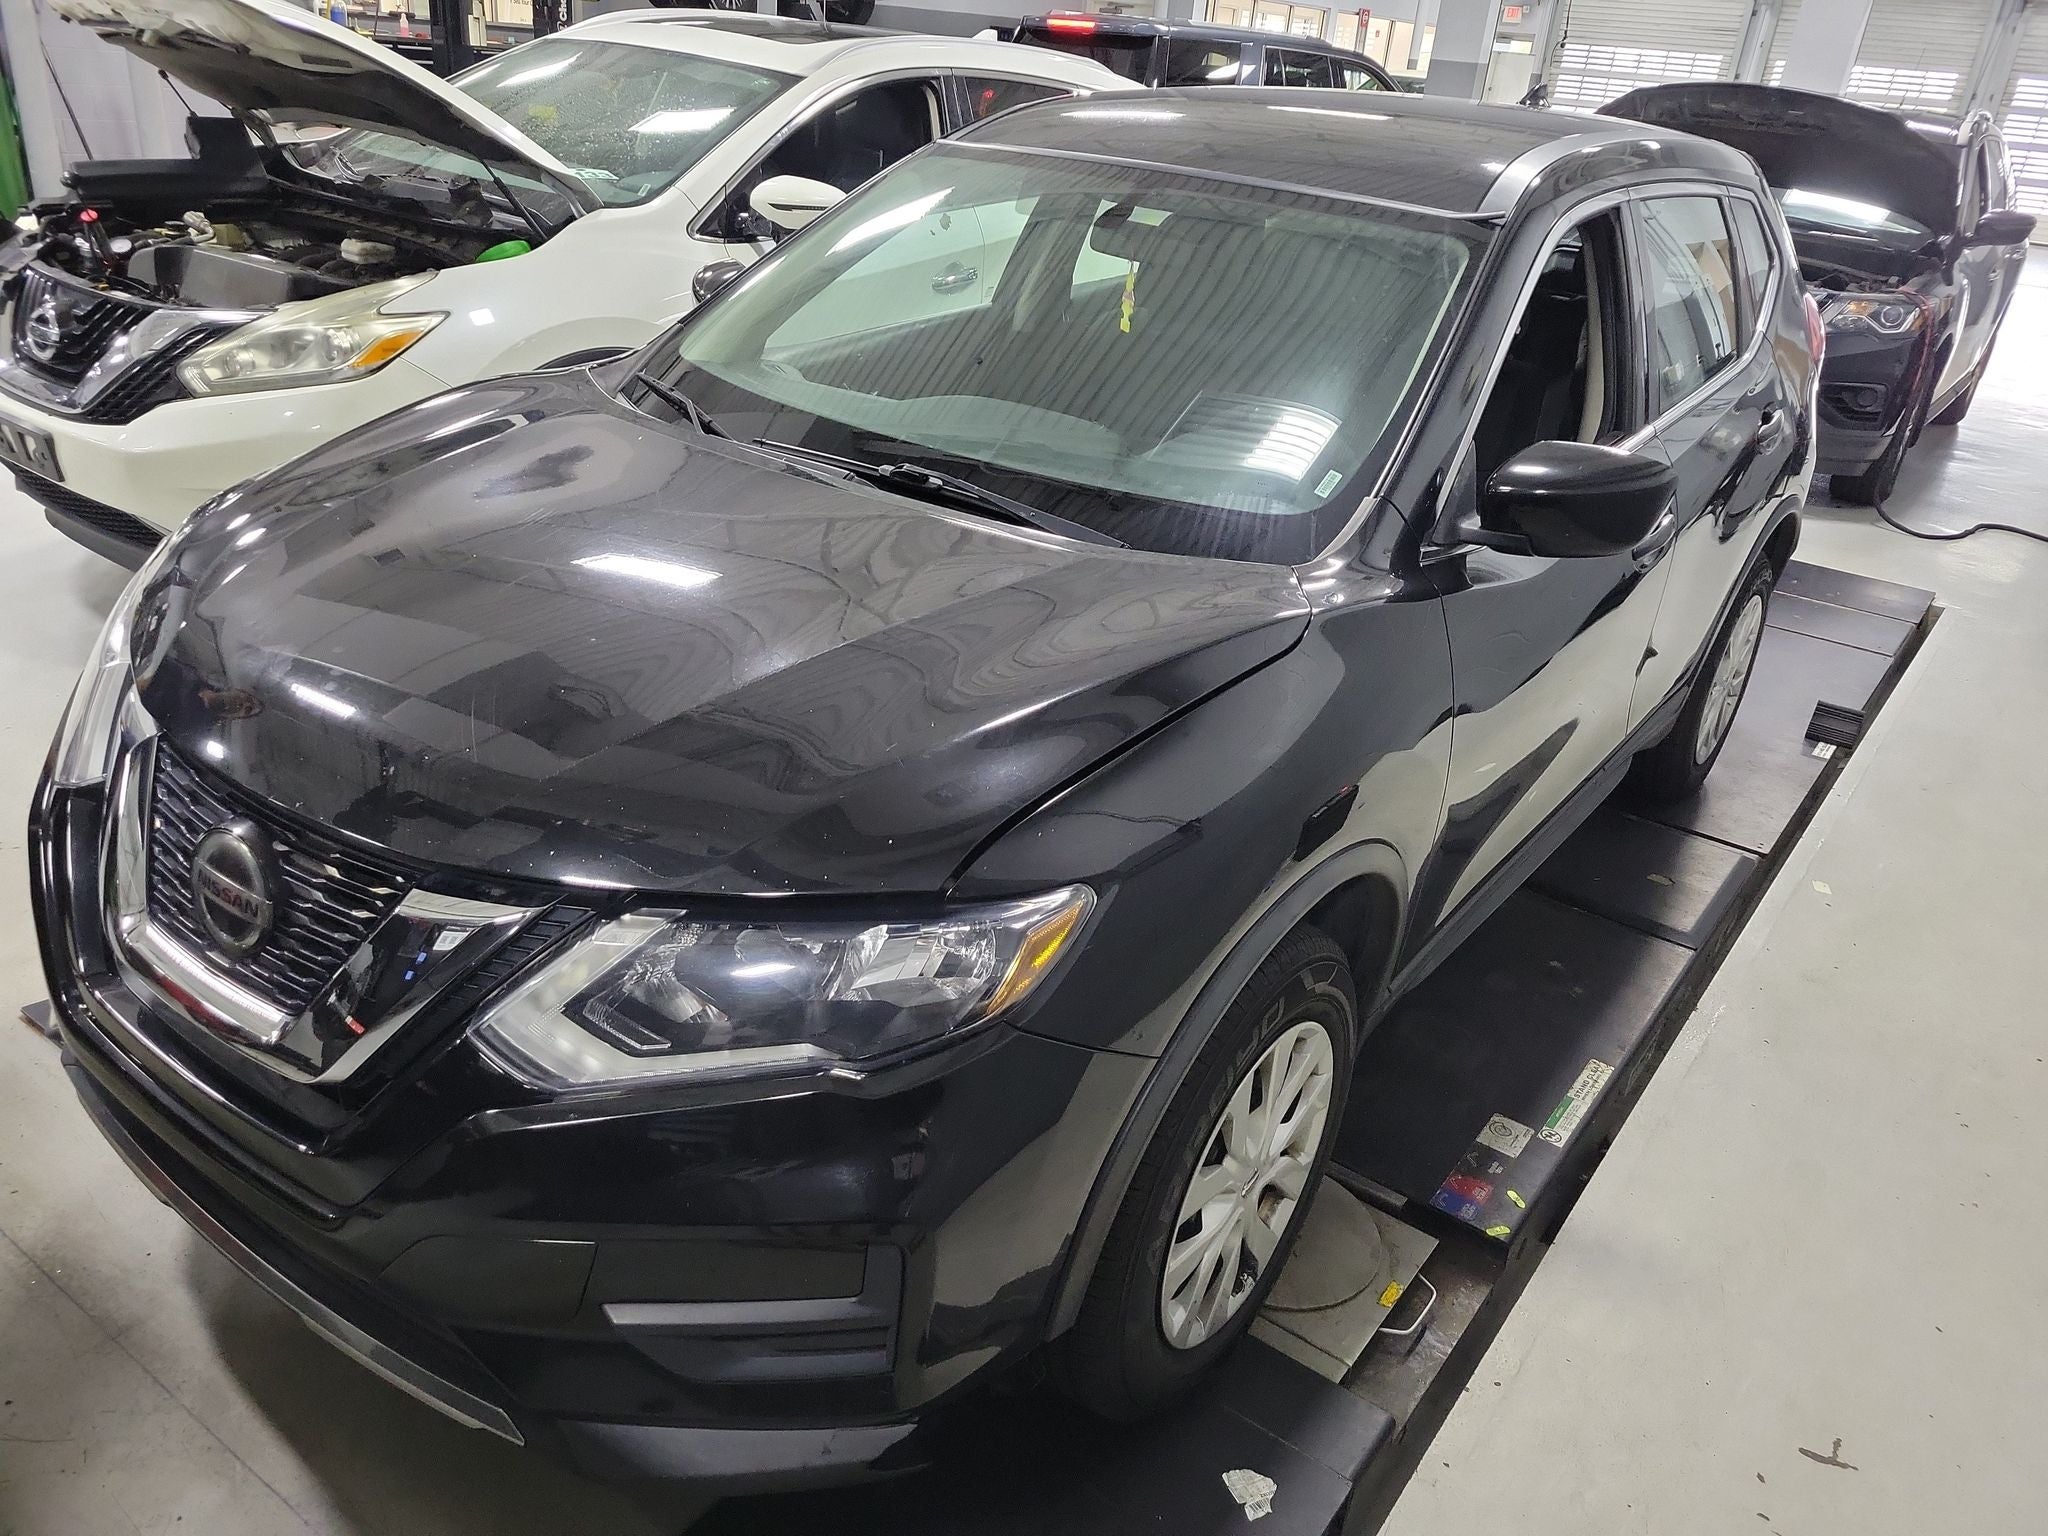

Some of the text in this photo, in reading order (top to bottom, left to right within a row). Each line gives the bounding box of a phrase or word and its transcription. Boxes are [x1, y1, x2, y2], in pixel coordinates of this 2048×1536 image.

[1507, 7, 1520, 17] EXIT
[198, 868, 259, 919] NISSAN
[1574, 1079, 1590, 1098] STAND
